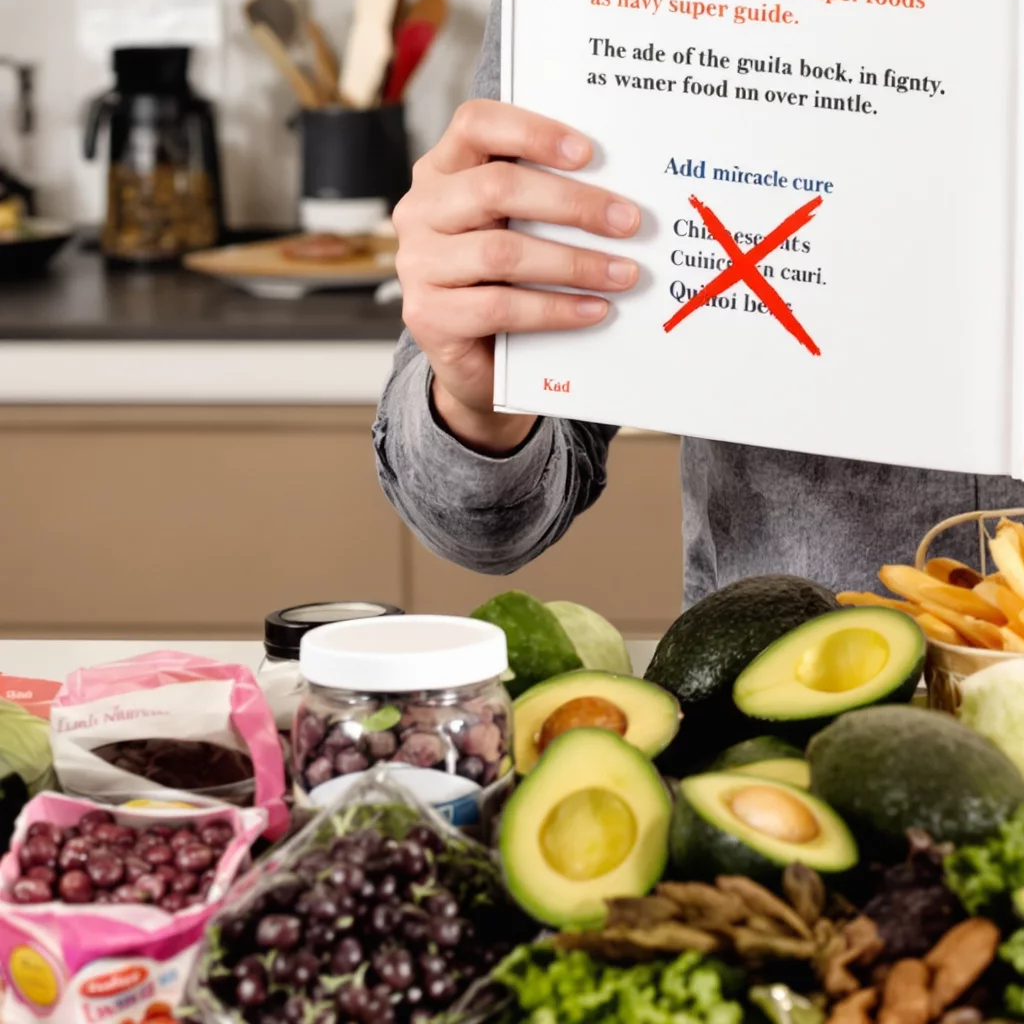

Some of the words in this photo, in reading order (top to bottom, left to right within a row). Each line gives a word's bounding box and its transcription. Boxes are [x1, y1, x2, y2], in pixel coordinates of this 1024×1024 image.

[669, 0, 728, 19] super
[733, 3, 799, 24] guide.
[589, 37, 627, 58] The
[632, 43, 666, 62] ade
[673, 47, 696, 65] of
[699, 49, 730, 69] the
[859, 66, 878, 86] in
[587, 71, 607, 86] as
[614, 74, 677, 92] waner
[683, 76, 728, 98] food
[765, 89, 808, 107] over
[664, 157, 706, 179] Add
[792, 176, 834, 193] cure
